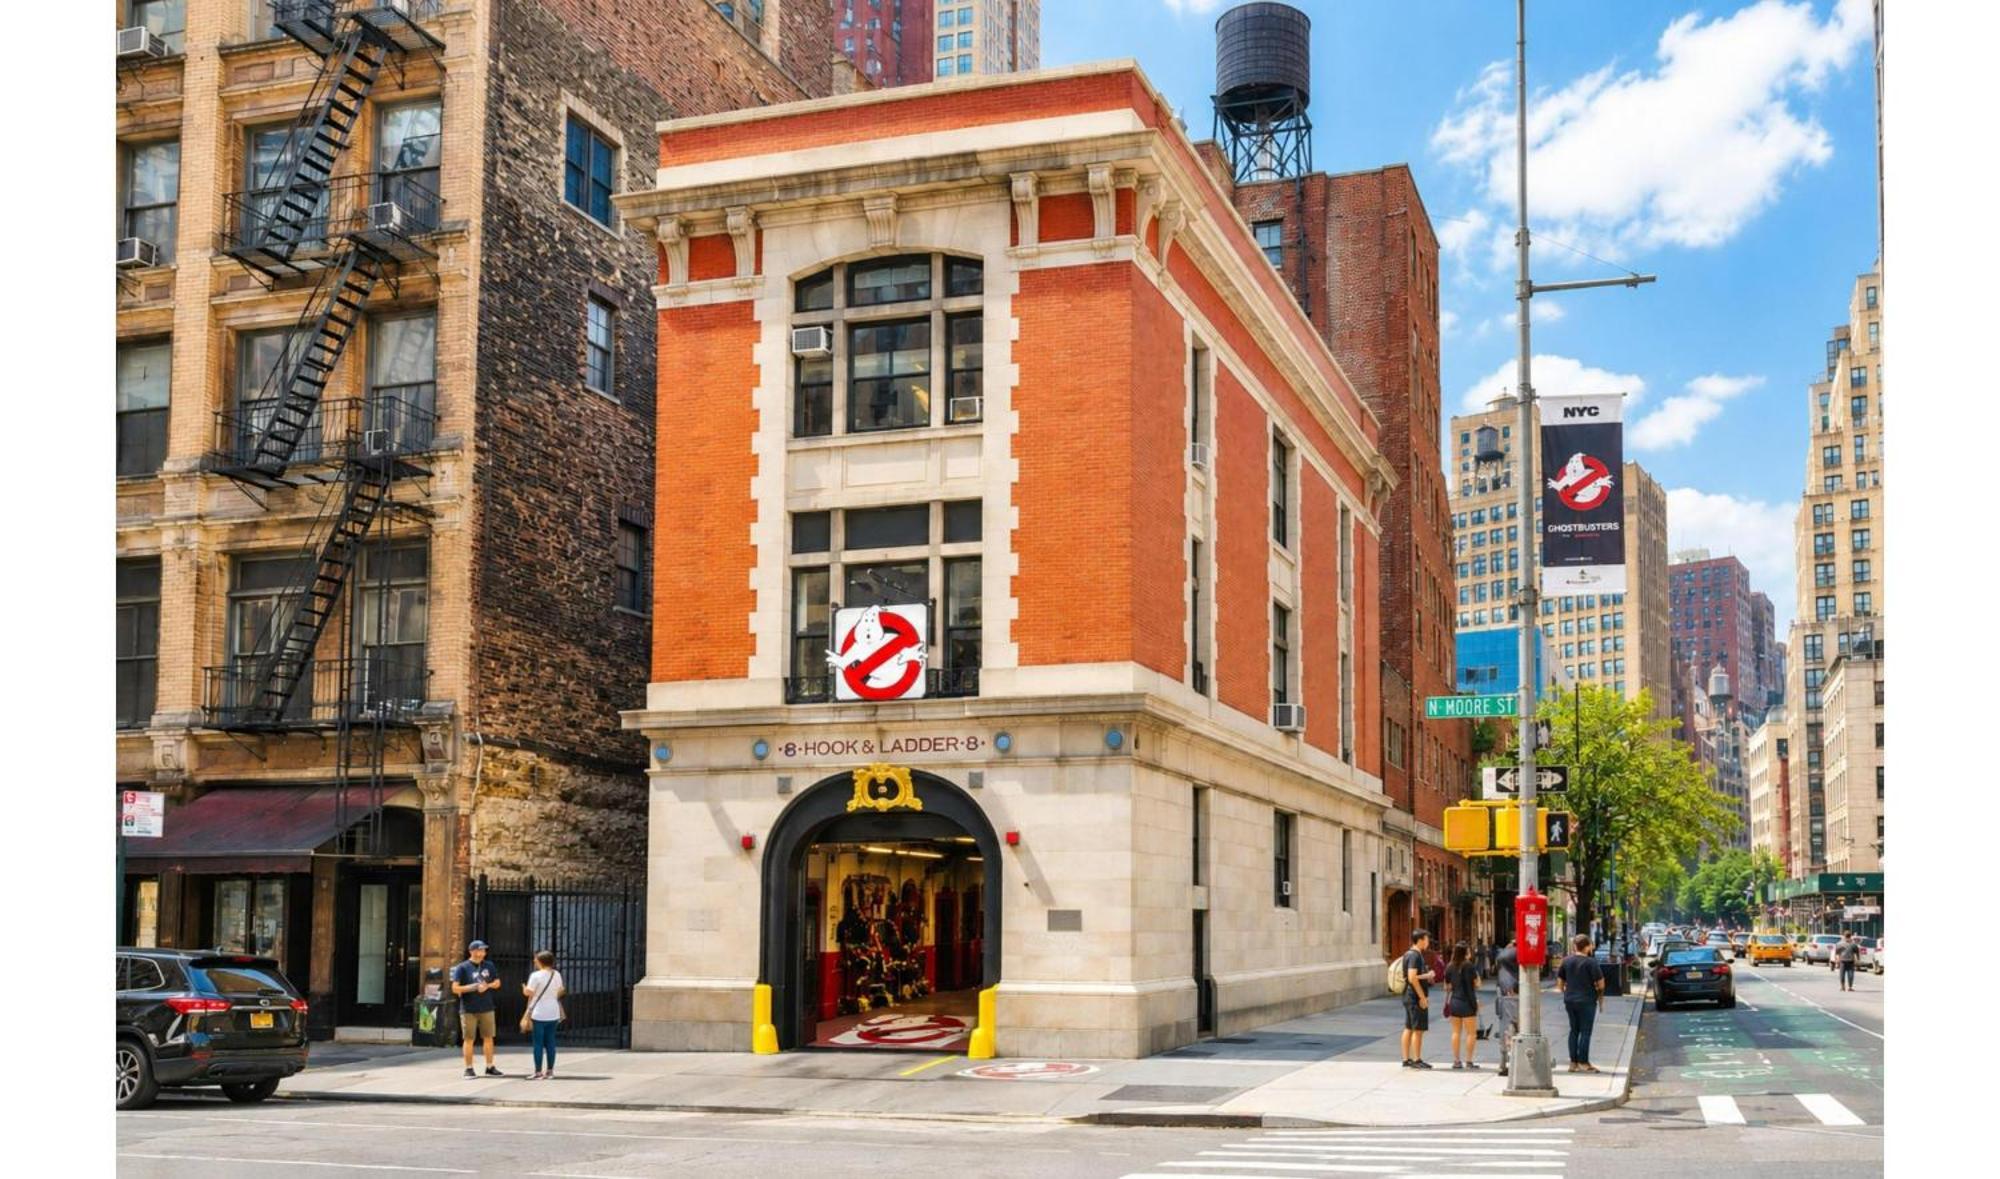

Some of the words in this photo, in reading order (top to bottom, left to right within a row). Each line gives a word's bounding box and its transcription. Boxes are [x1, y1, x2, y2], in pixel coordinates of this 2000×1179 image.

[1563, 406, 1600, 418] NYC
[1547, 522, 1620, 533] GHOSTBUSTERS
[1446, 698, 1490, 715] MOORE
[1496, 697, 1514, 714] ST
[861, 740, 875, 754] &
